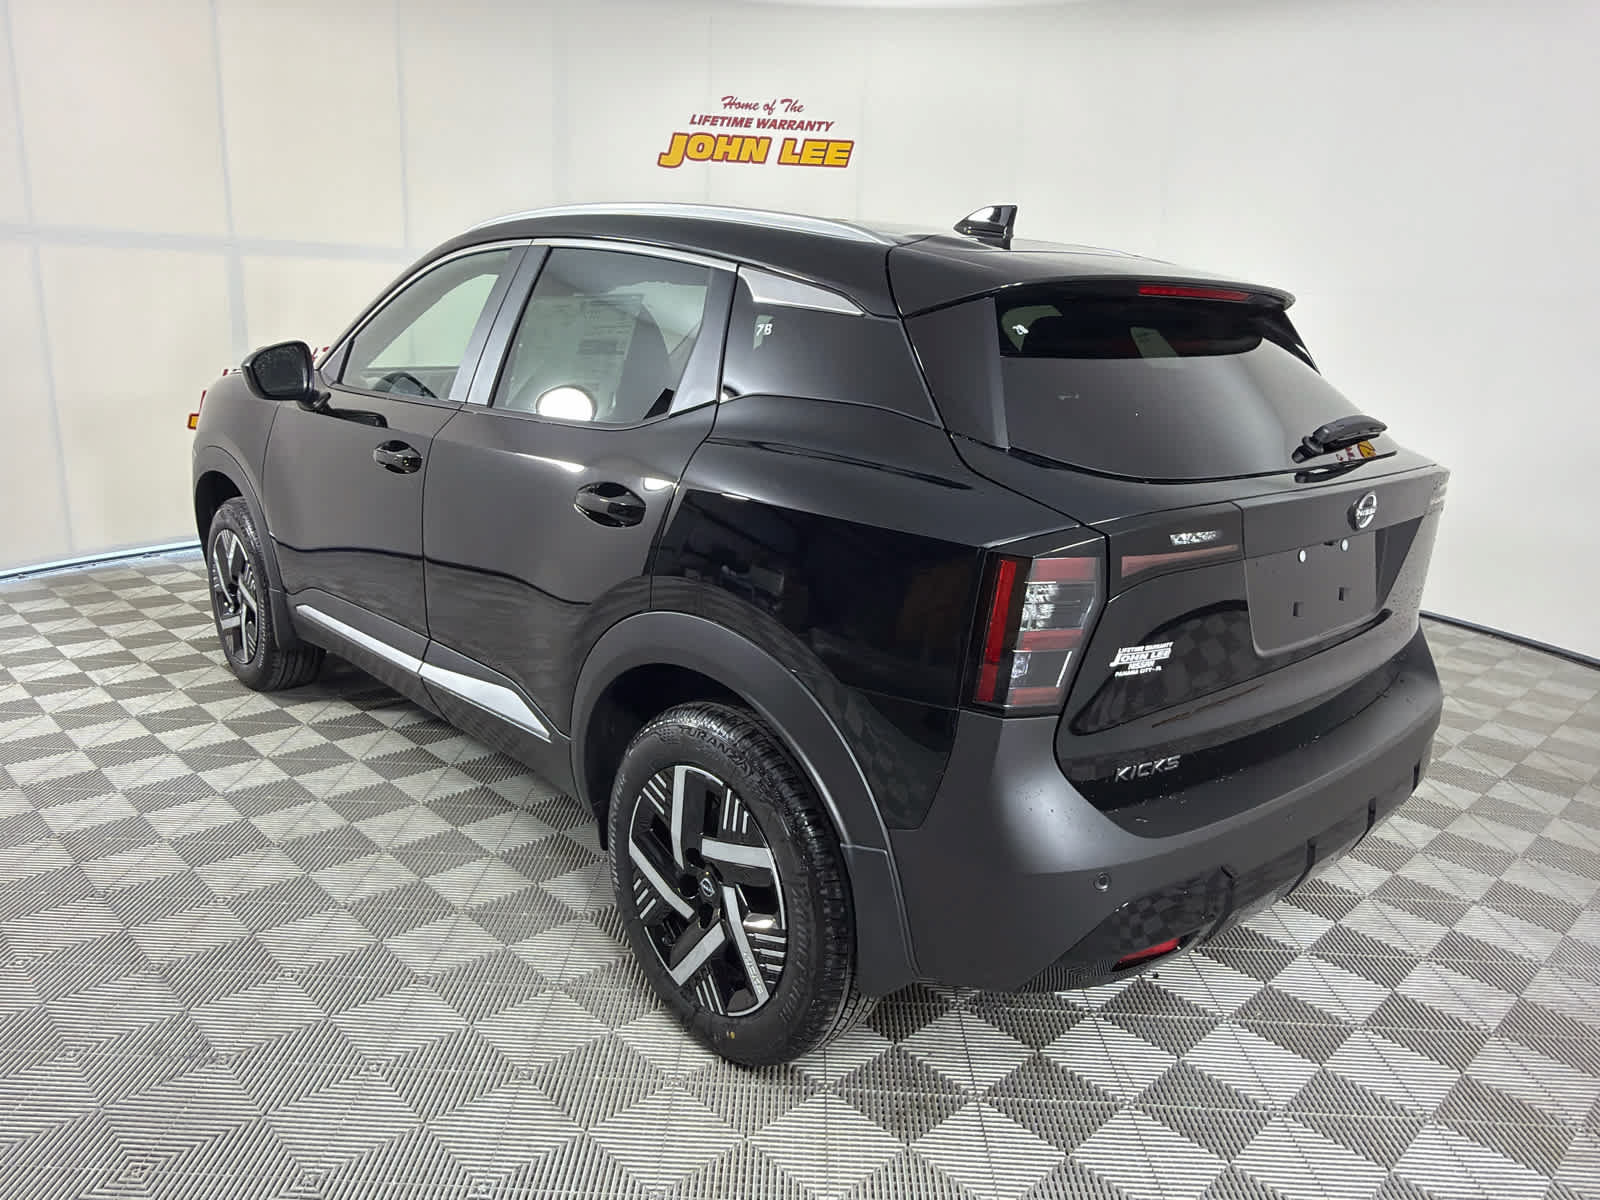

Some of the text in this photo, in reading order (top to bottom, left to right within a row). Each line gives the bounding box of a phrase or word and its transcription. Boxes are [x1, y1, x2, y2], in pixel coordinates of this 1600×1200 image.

[721, 95, 805, 115] Home of The
[689, 114, 835, 132] LIFETIME WARRANTY
[657, 132, 855, 168] JOHN LEE
[1114, 754, 1182, 783] KICKS
